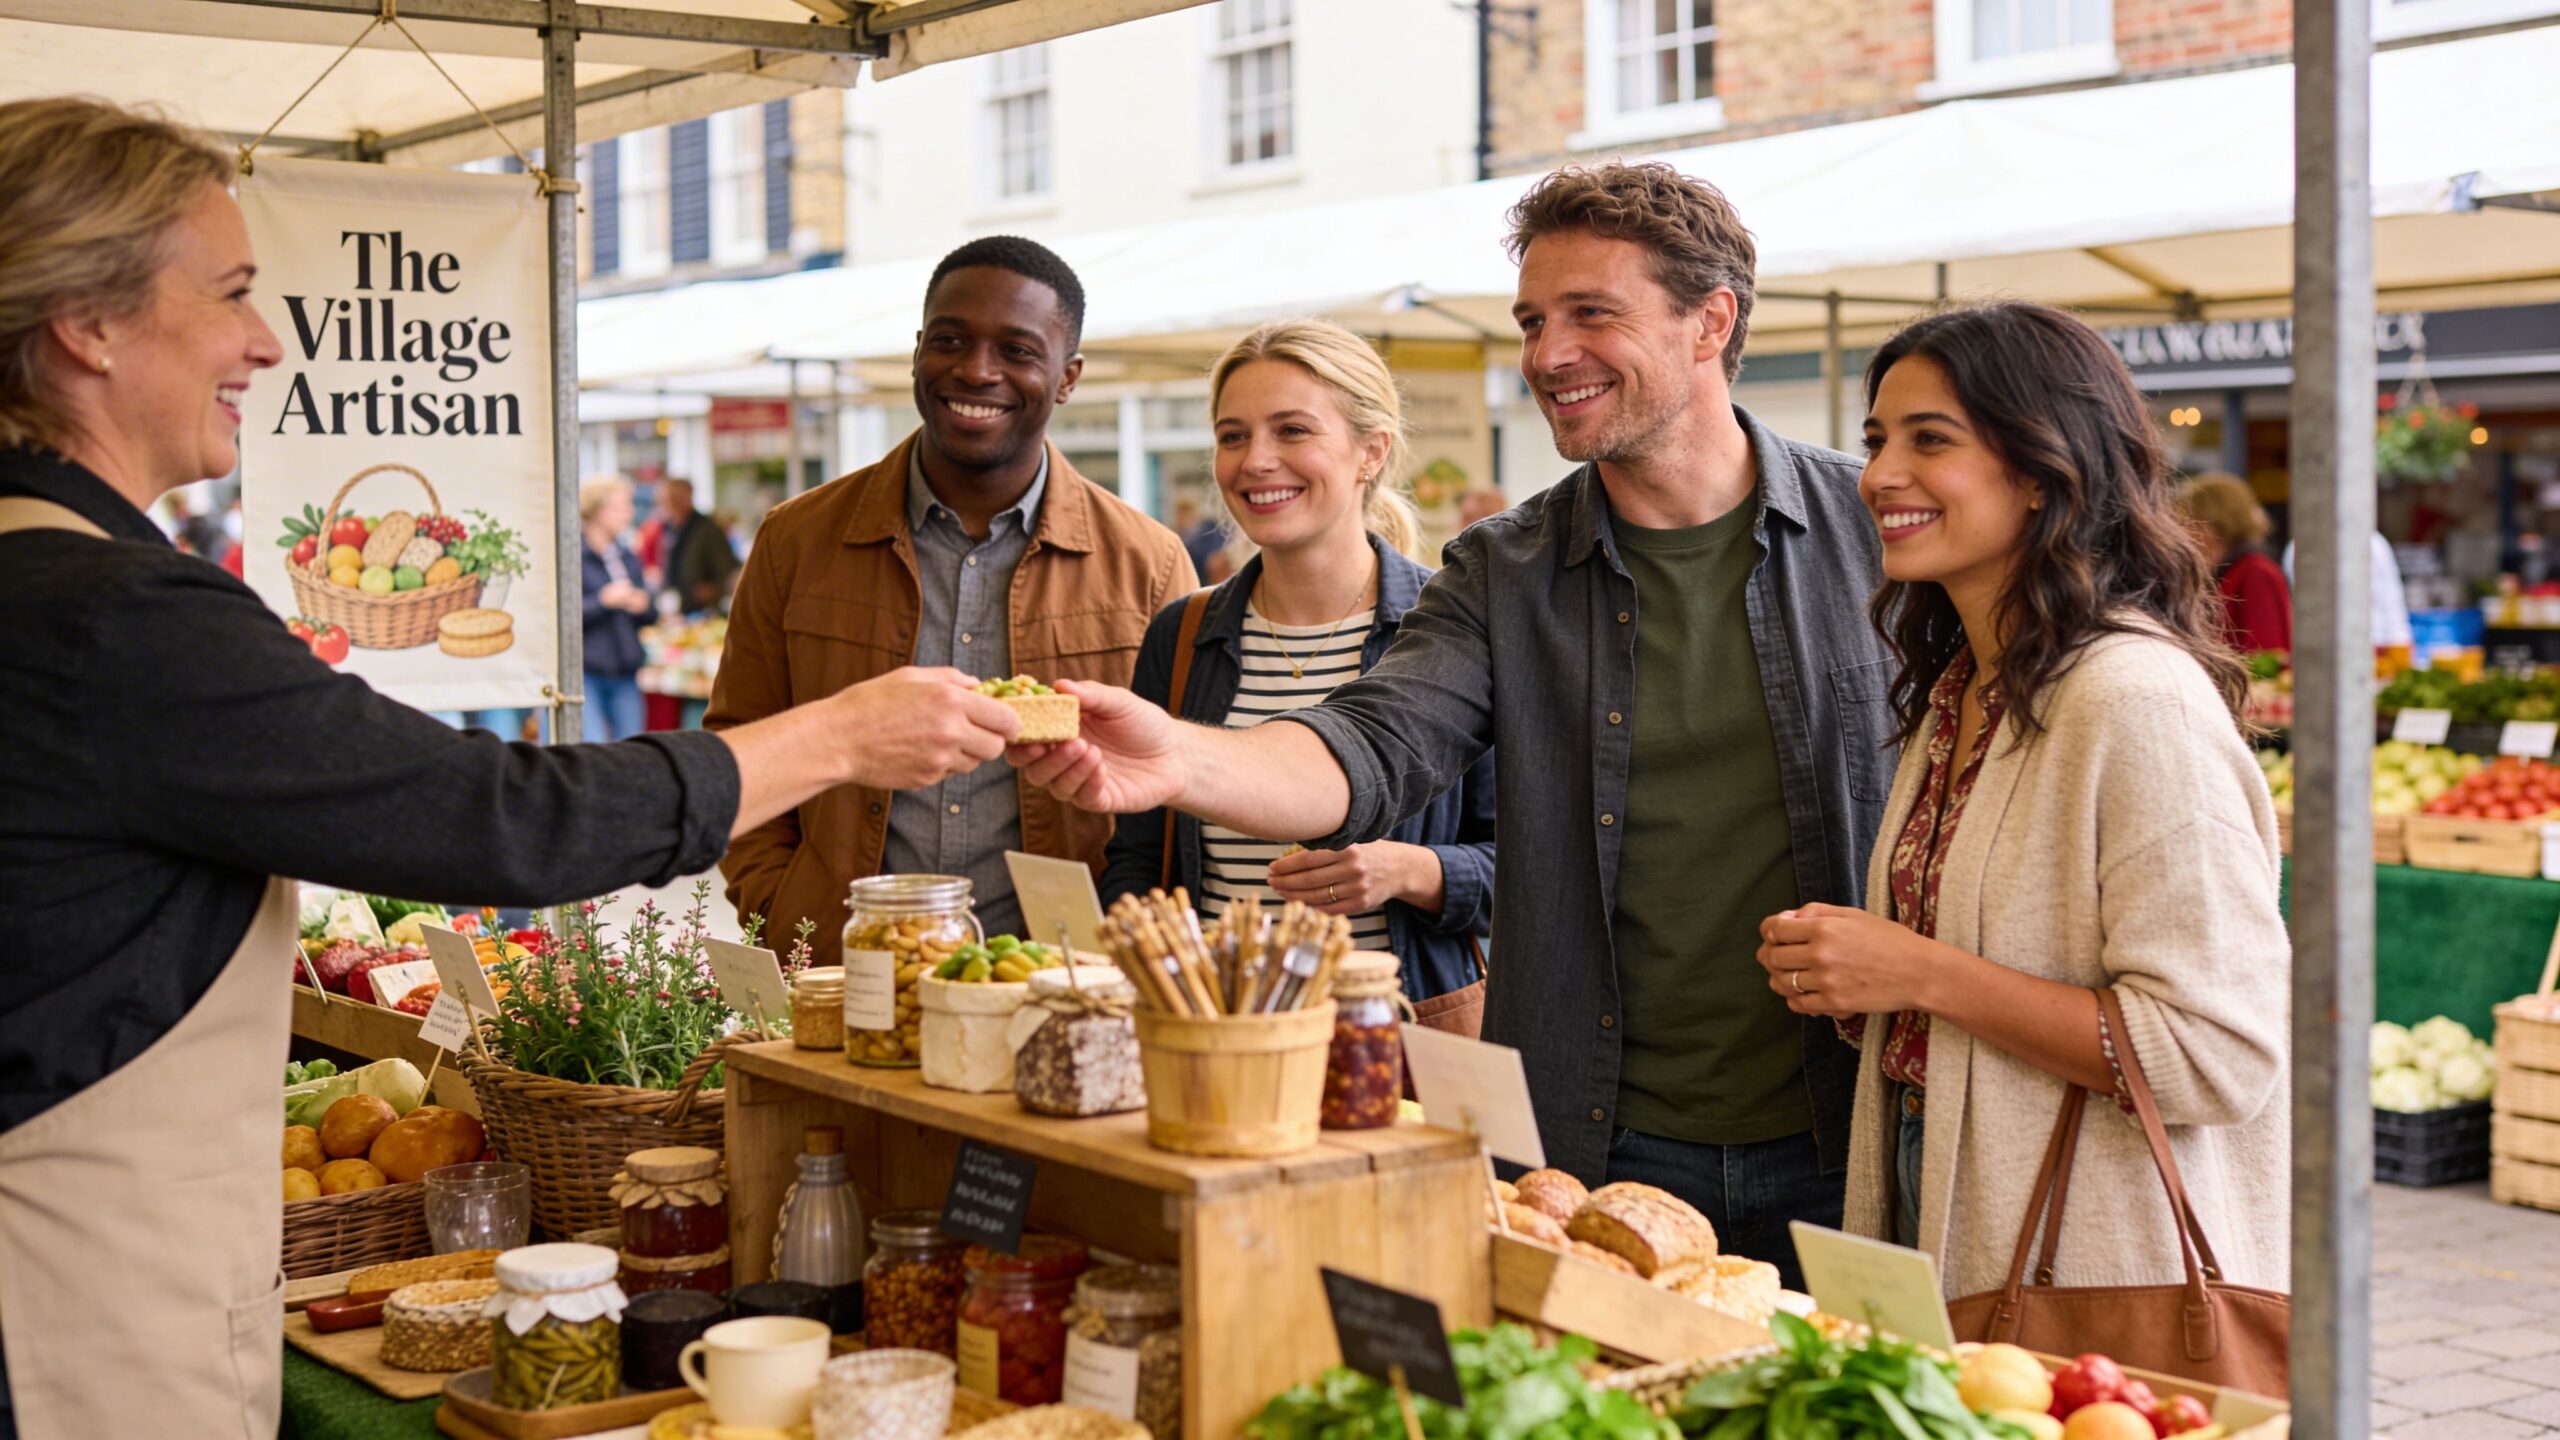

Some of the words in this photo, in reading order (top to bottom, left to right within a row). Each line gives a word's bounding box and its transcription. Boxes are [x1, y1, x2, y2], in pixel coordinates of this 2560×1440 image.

[341, 230, 461, 294] The
[281, 295, 512, 382] Village
[271, 372, 522, 436] Artisan
